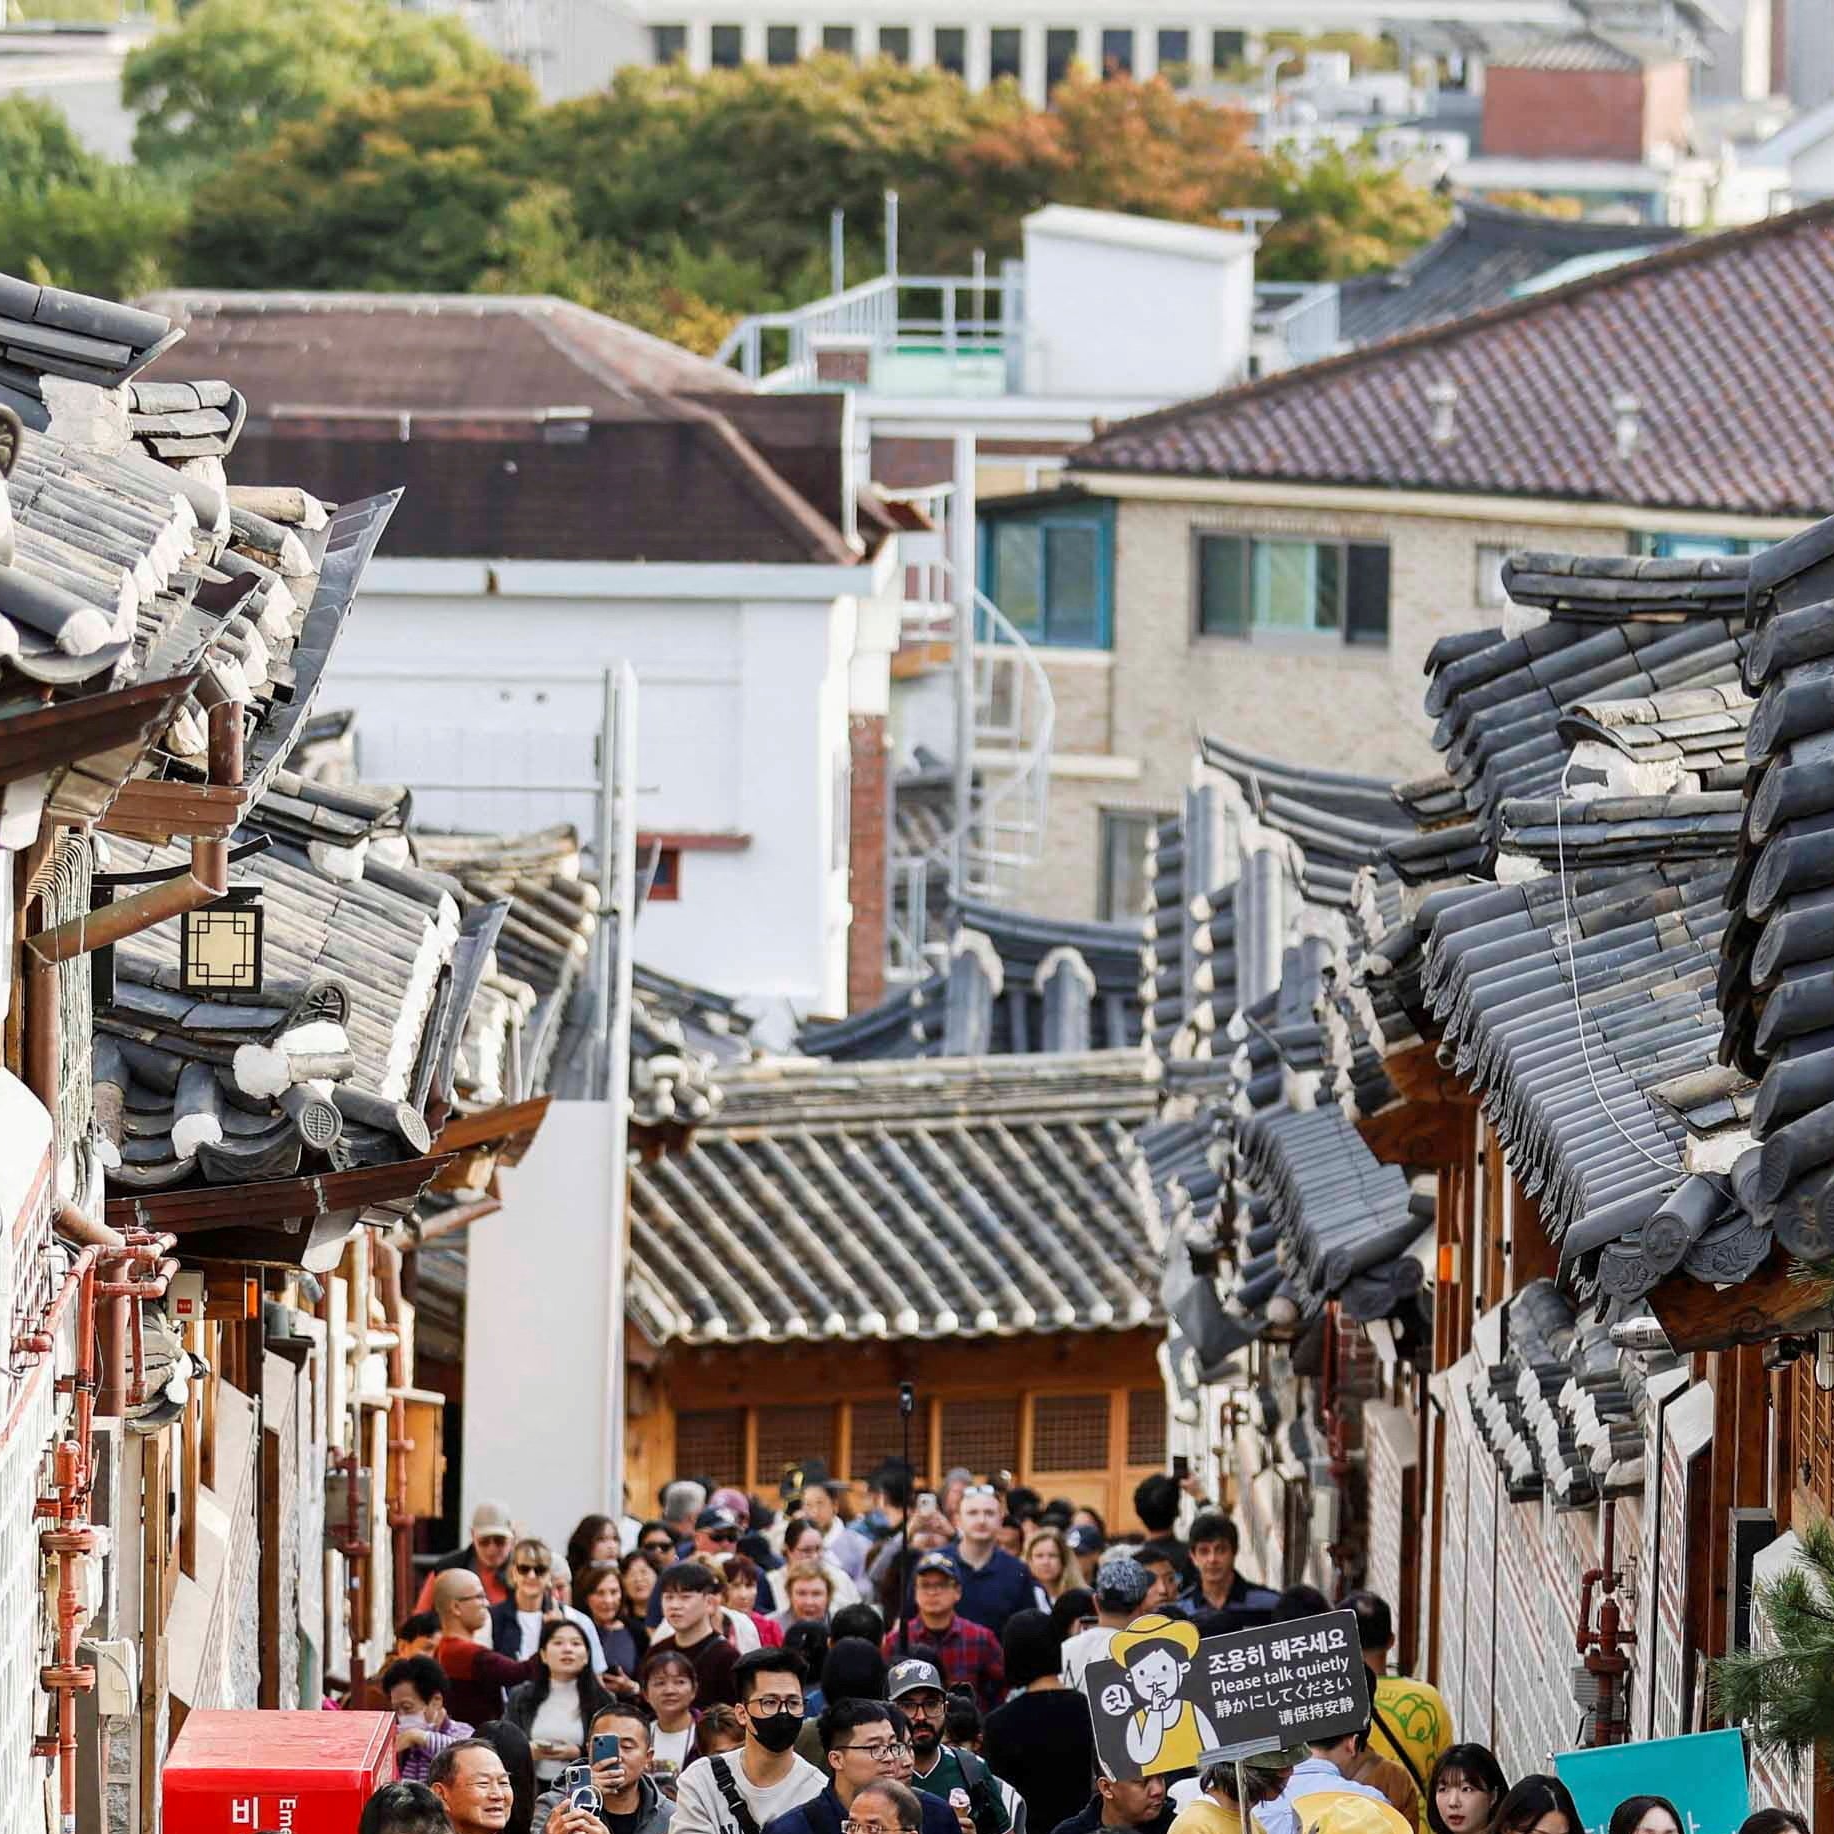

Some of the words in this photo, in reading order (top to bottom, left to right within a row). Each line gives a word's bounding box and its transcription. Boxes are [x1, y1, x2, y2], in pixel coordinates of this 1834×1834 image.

[1208, 1644, 1266, 1675] 조용히
[1271, 1628, 1348, 1661] 해주세요
[1211, 1676, 1261, 1696] Please
[1263, 1666, 1294, 1686] talk
[1296, 1655, 1350, 1681] quietly
[1105, 1687, 1126, 1712] 쉿
[1214, 1676, 1352, 1718] 静かにしてください
[1278, 1696, 1355, 1726] 请保持安静
